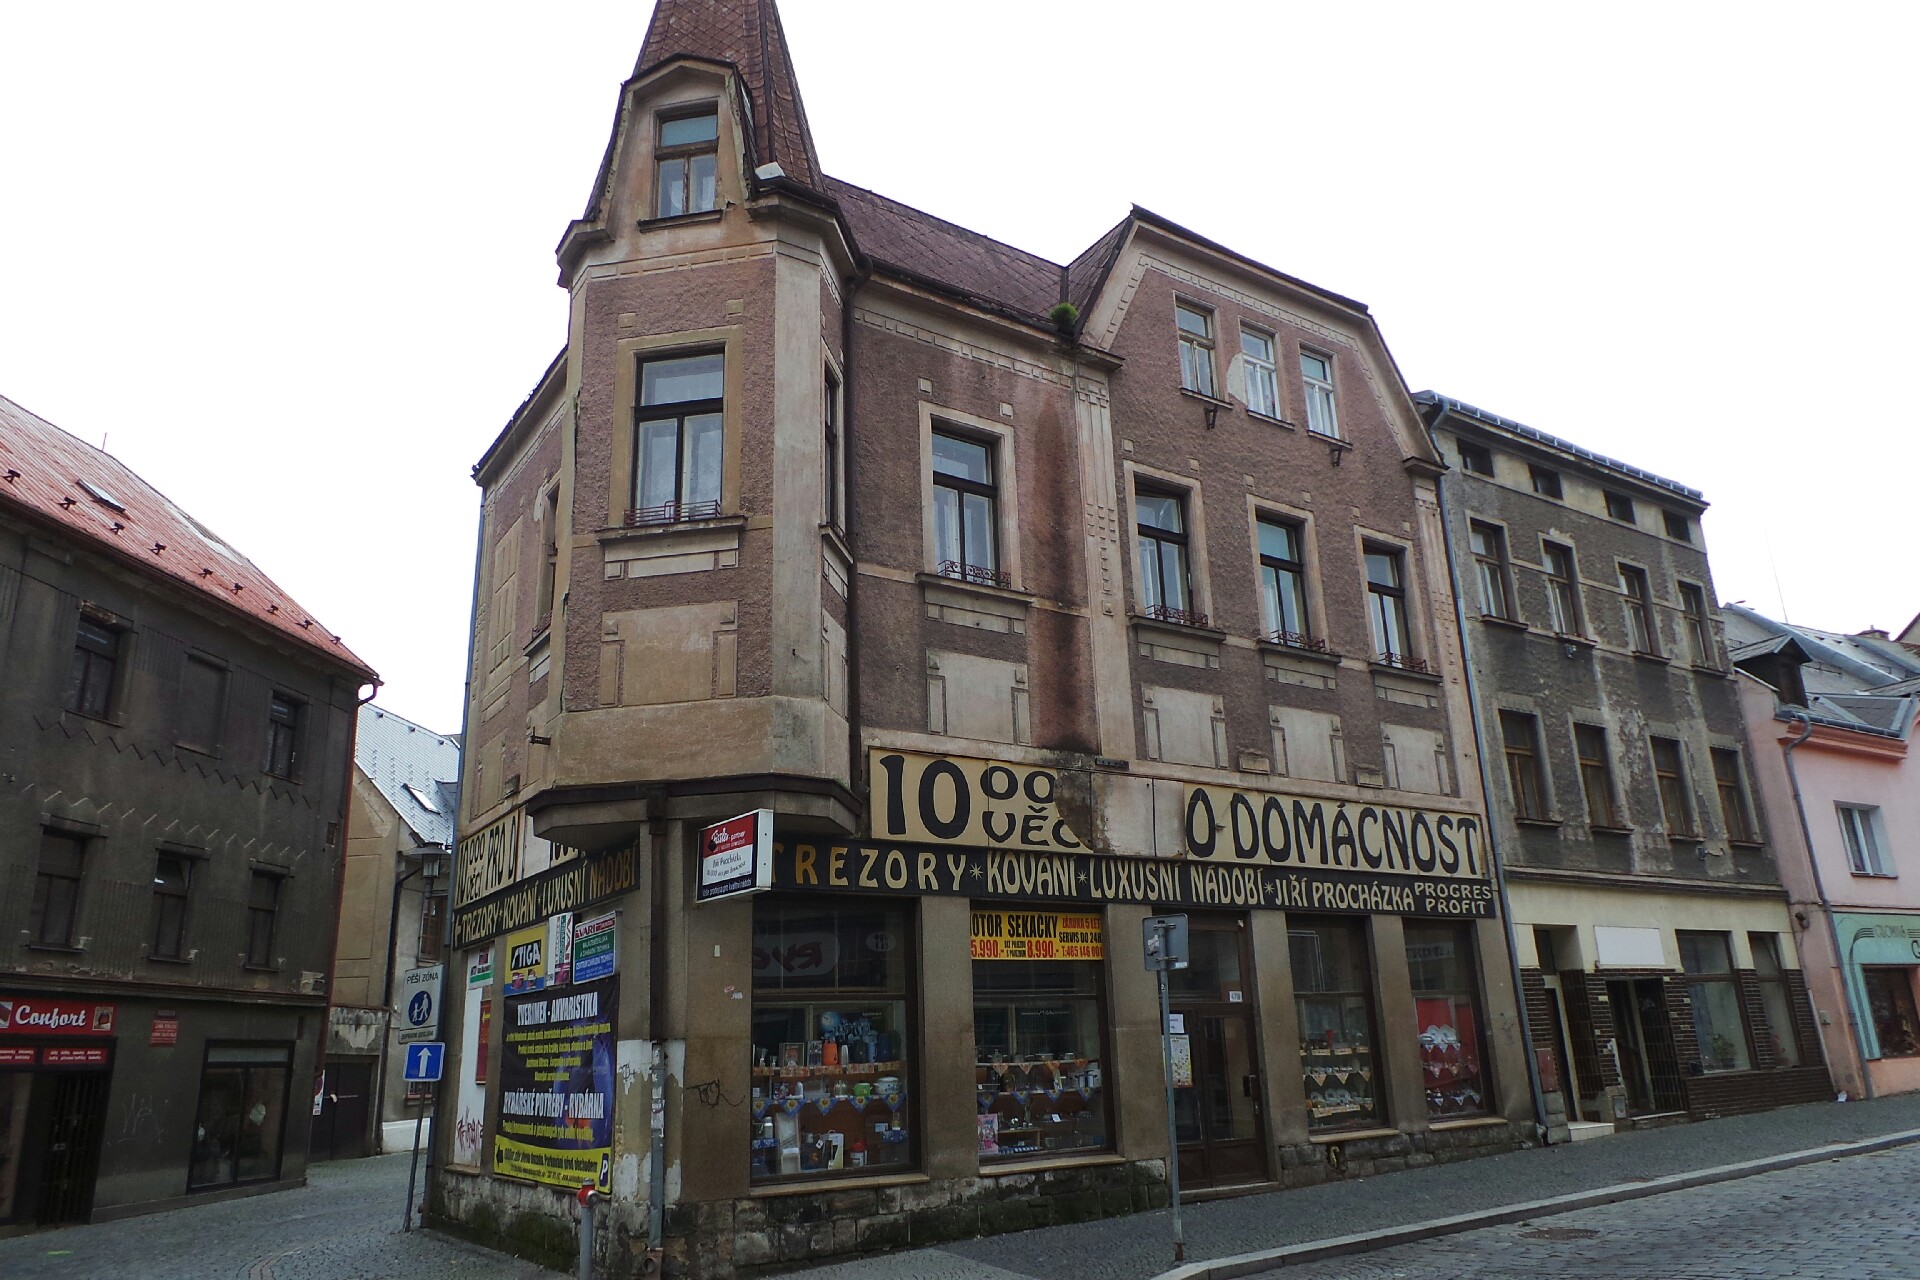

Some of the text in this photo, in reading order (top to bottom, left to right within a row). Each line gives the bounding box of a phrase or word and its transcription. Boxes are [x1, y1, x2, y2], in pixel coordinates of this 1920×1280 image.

[880, 755, 970, 839] 10
[1230, 793, 1478, 875] DOMÁCNOST
[486, 822, 505, 890] PRO
[462, 900, 499, 944] TREZORY
[503, 880, 538, 930] KOVÁNÍ
[542, 860, 587, 917] LUXUSNÍ
[590, 840, 638, 901] NÁDOBÍ
[987, 851, 1077, 897] KOVÁNÍ
[1089, 857, 1182, 901] LUXUSNÍ
[1190, 864, 1265, 906] NÁDOBÍ
[1274, 875, 1307, 908] JIŘÍ
[1312, 880, 1415, 912] PROCHÁZKA
[1414, 882, 1492, 899] PROGRES
[1425, 898, 1486, 915] PROFIT
[578, 921, 596, 938] VARI
[970, 913, 1058, 938] OTOR SEKAČKY
[1062, 916, 1101, 930] ZÁRUKA 5 LET
[1059, 931, 1079, 943] SERVIS
[1080, 932, 1089, 943] DO
[512, 942, 541, 969] STIGA
[1080, 946, 1090, 957] 146
[422, 971, 439, 982] ZÓNA
[551, 991, 598, 1022] AKVARISTIKA
[503, 1088, 535, 1116] RYBÁŘSKÉ
[535, 1088, 565, 1118] POTŘEBY
[569, 1088, 604, 1119] RYBÁRNA
